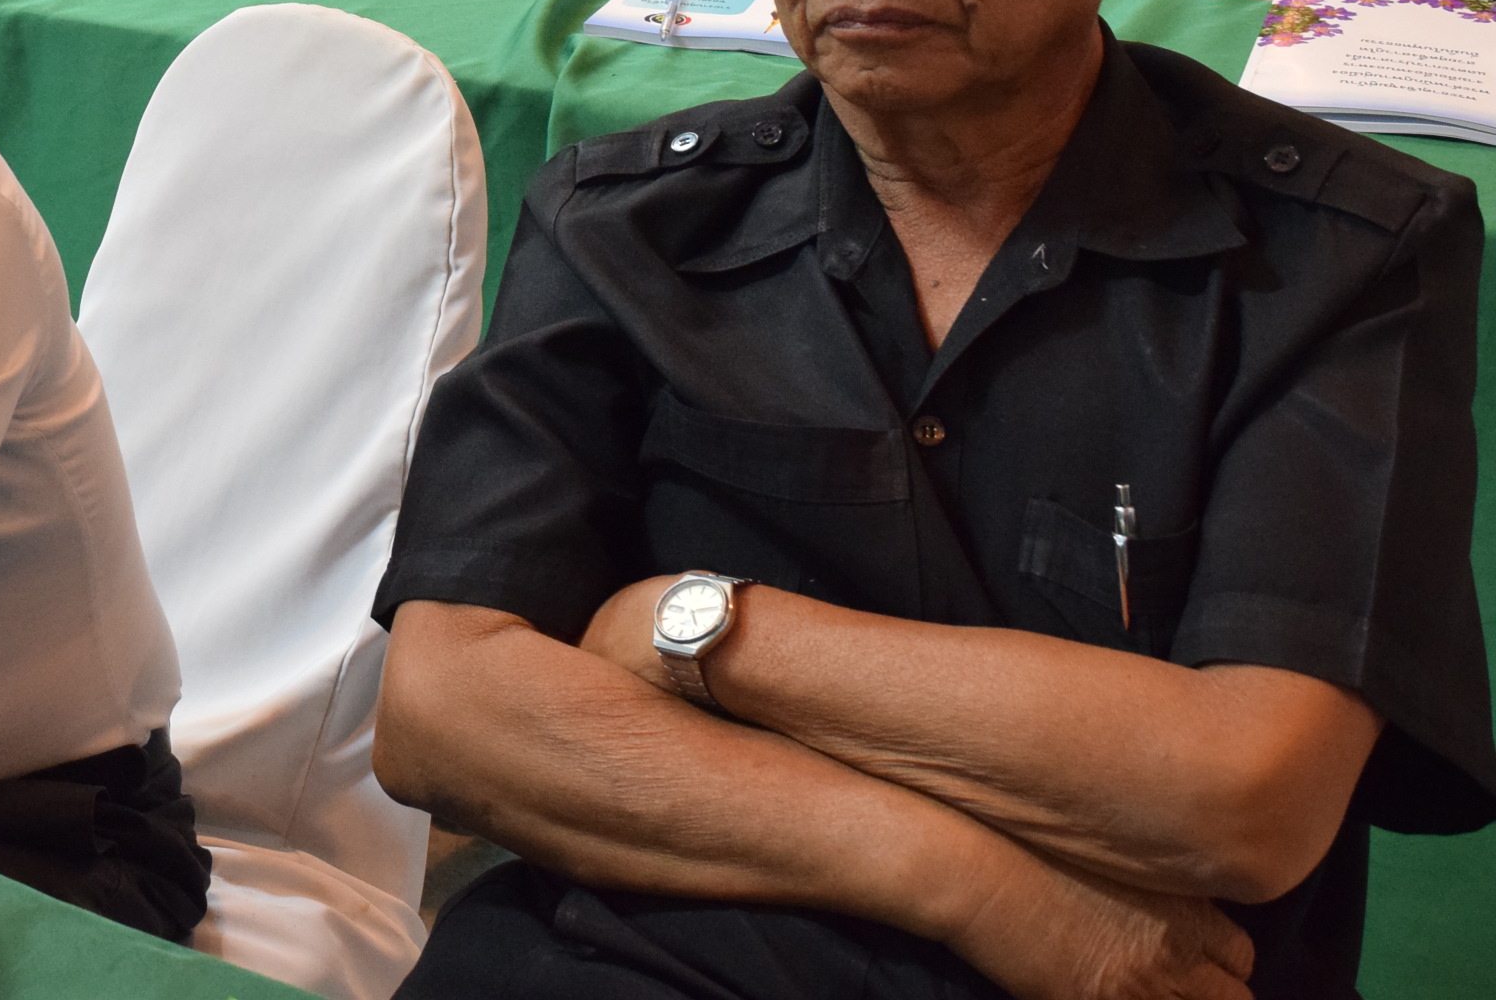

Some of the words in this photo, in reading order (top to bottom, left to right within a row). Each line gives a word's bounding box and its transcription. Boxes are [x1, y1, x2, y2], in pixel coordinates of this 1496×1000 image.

[1359, 38, 1479, 58] ถิ่นมั่นในพุทธธรรม
[1359, 45, 1476, 66] สวยสุดซึ้งสาวภูไท
[1342, 61, 1485, 85] งามลือเลื่องหนองหาร
[1345, 53, 1487, 77] แลตระการปราสาทผึ้ง
[1331, 68, 1492, 96] พระตำหนักภูพานคู่เมือง
[1339, 78, 1478, 102] พระธาตุเชิงชุมคู่บ้าน
